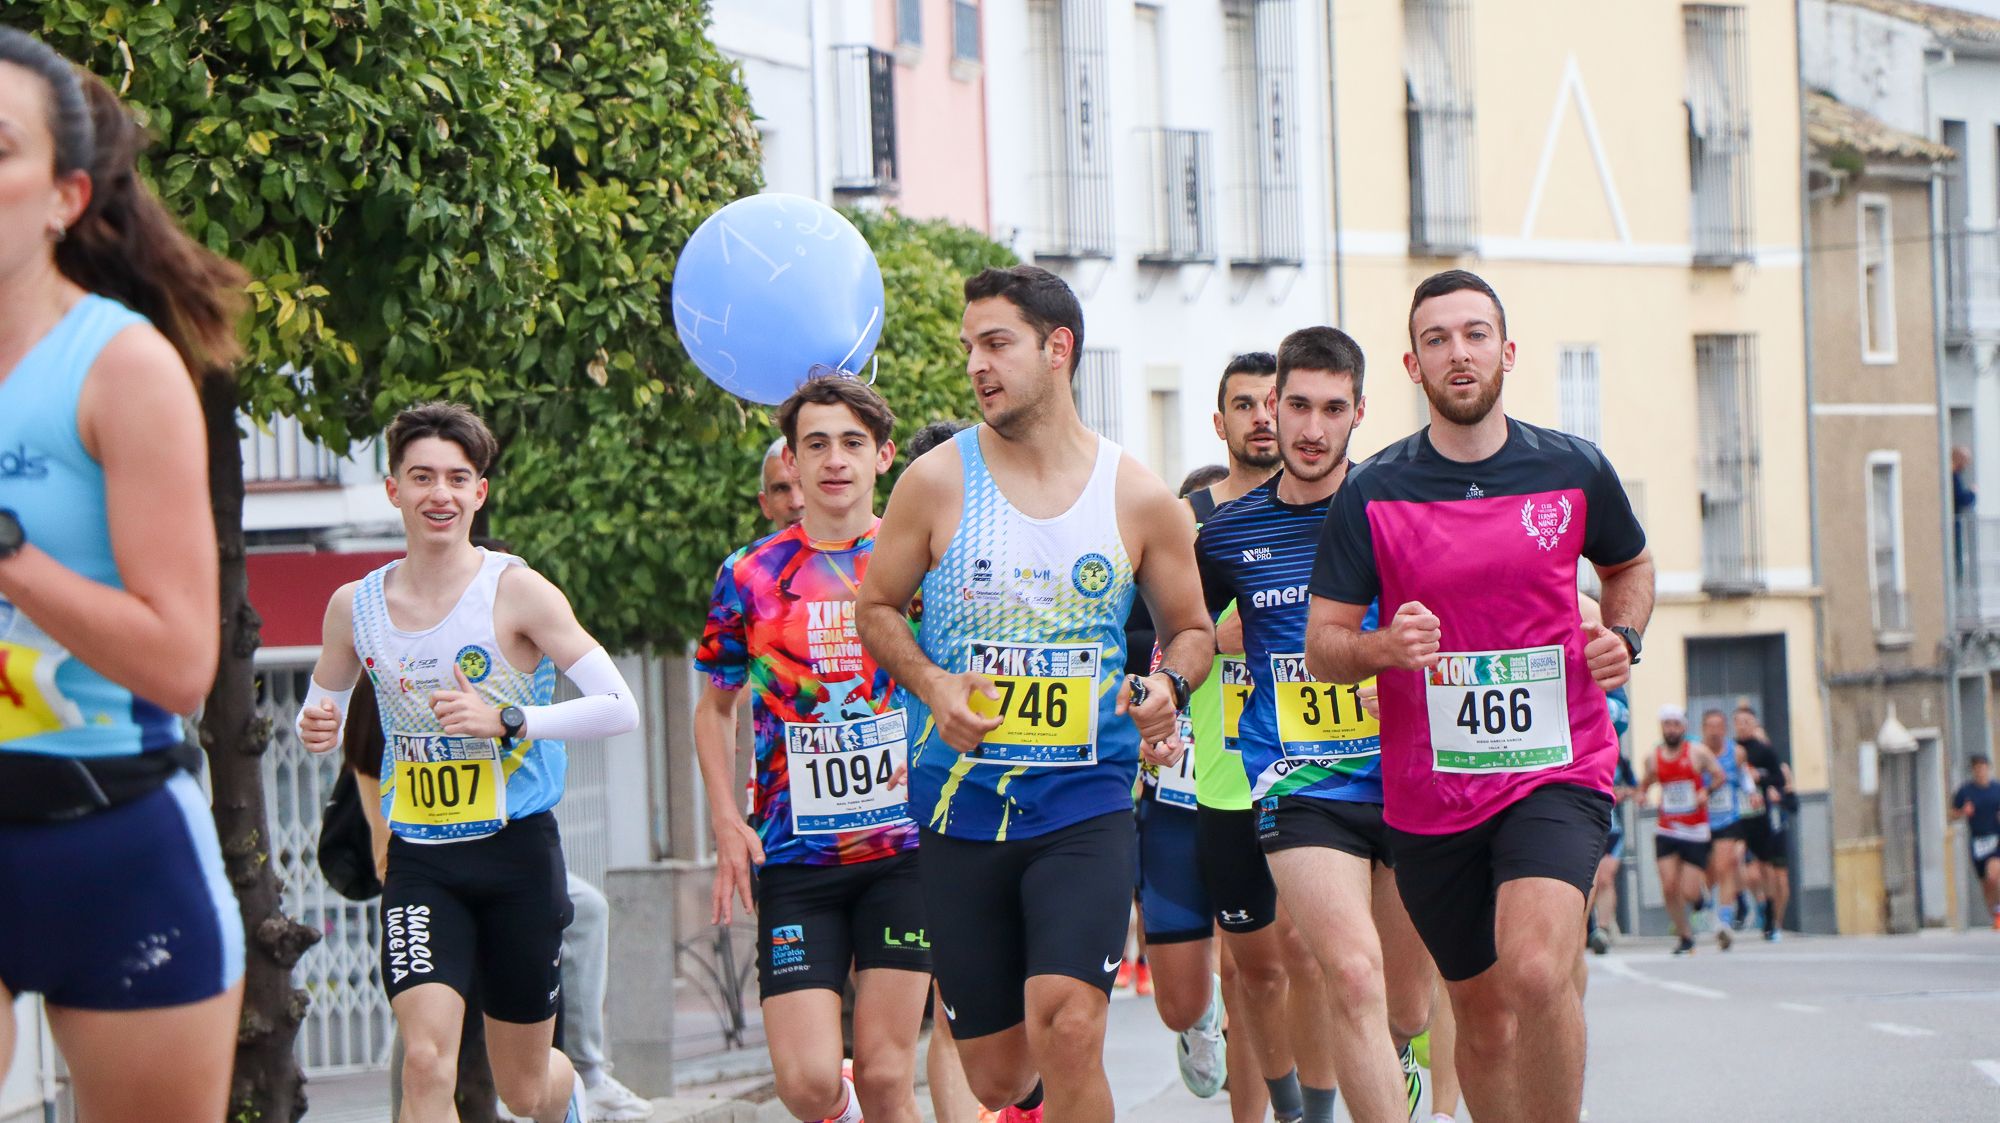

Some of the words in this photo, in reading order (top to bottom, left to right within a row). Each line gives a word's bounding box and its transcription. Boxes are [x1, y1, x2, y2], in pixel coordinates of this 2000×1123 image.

[1252, 584, 1312, 609] ener
[806, 600, 841, 630] XII
[808, 629, 844, 645] MEDIA
[808, 640, 862, 659] MARATÓN
[819, 659, 840, 674] 10K
[984, 646, 1027, 676] 21K
[1437, 656, 1479, 685] 10K
[994, 680, 1068, 728] 746
[1300, 684, 1364, 726] 311
[1456, 687, 1532, 735] 466
[400, 736, 429, 762] 21K
[801, 727, 841, 753] 21K
[406, 763, 480, 809] 1007
[805, 748, 893, 799] 1094
[405, 904, 434, 974] SURCO
[773, 944, 790, 953] Club
[772, 948, 806, 960] Maratón
[773, 955, 803, 967] Lucena
